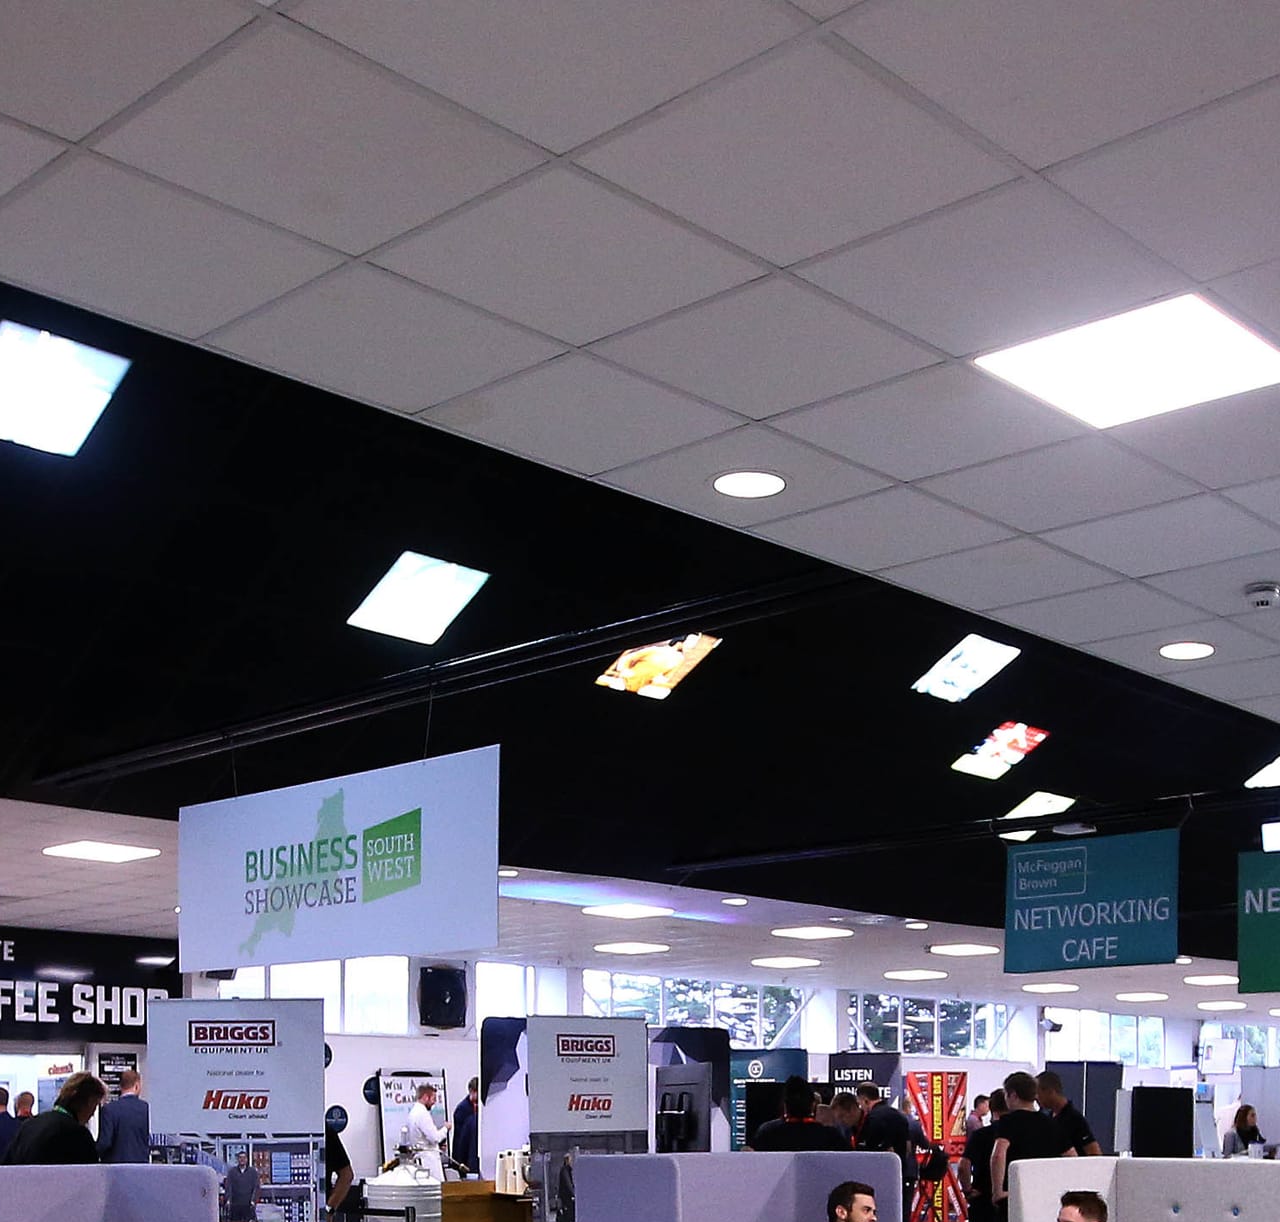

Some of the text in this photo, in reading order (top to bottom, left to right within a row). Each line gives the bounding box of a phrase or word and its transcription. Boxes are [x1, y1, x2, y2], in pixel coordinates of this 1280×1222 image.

[366, 832, 415, 857] SOUTH
[246, 834, 359, 883] BUSINESS
[367, 856, 416, 882] WEST
[1018, 858, 1082, 874] McFeggan
[1019, 877, 1057, 890] Brown
[245, 876, 357, 915] SHOWCASE
[1014, 897, 1170, 931] NETWORKING
[1062, 936, 1119, 962] CAFE
[194, 1026, 270, 1041] BRIGGS
[561, 1040, 612, 1052] BRIGGS
[834, 1069, 873, 1081] LISTEN
[202, 1089, 270, 1110] Hako
[567, 1094, 614, 1111] Hako
